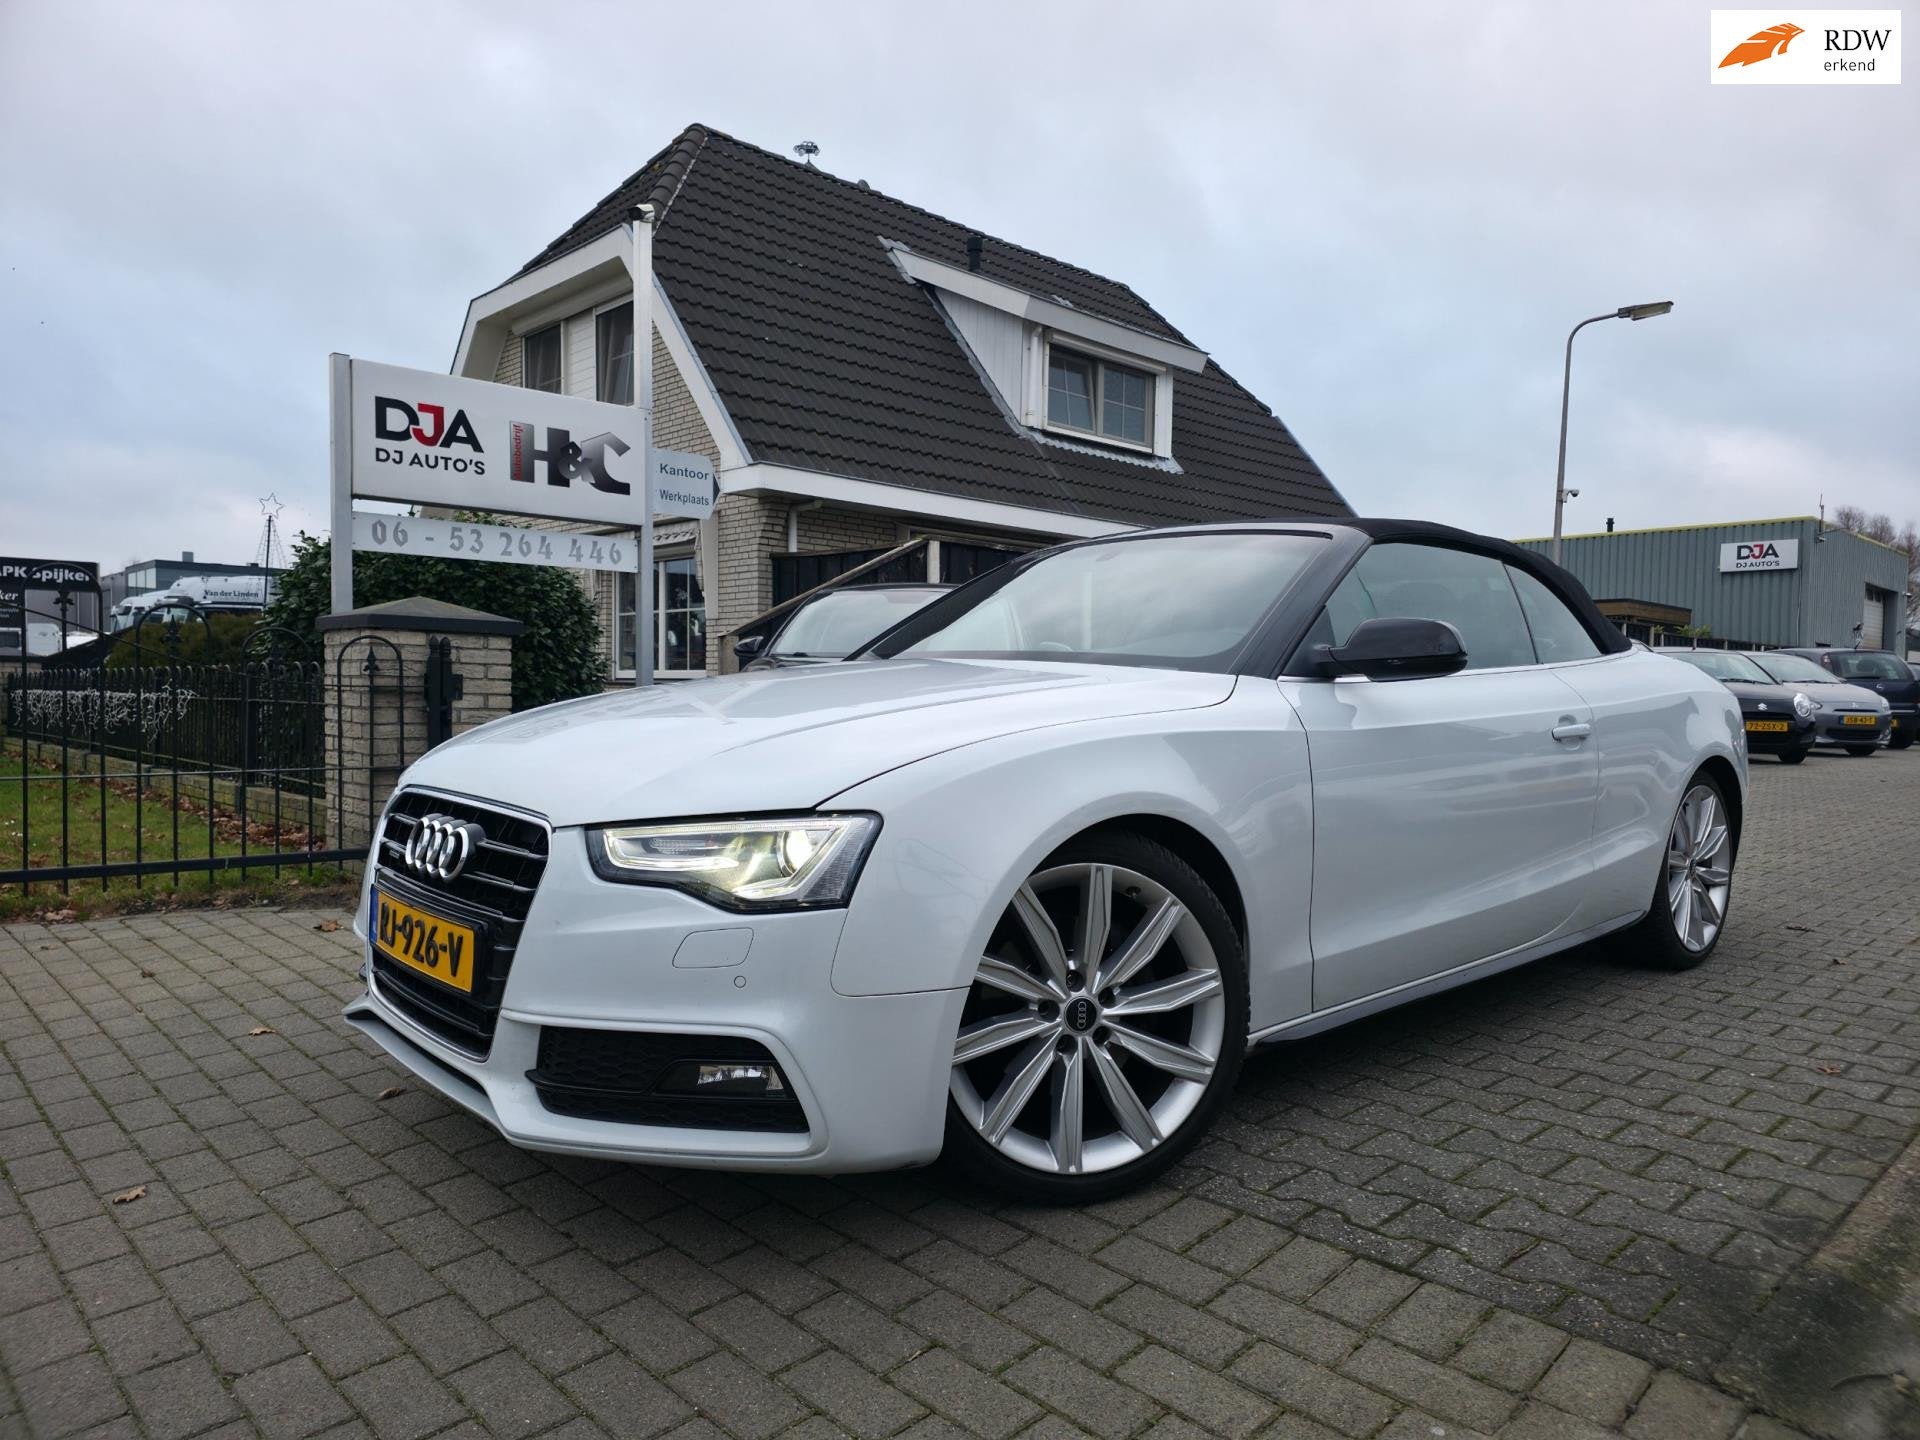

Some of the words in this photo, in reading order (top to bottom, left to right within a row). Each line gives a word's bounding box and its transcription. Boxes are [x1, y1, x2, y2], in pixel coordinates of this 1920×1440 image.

[375, 396, 484, 453] DJA
[375, 447, 404, 465] DJ
[409, 452, 485, 475] AUTO'S
[659, 463, 710, 480] Kantoor
[659, 489, 710, 506] Werkplaats
[371, 519, 409, 547] 06
[449, 526, 484, 554] 53
[500, 532, 554, 560] 264
[568, 538, 622, 564] 446
[1736, 543, 1779, 560] DJA
[0, 565, 27, 578] PK
[1749, 560, 1780, 568] AUTO'S
[380, 902, 464, 977] RJ-926-V
